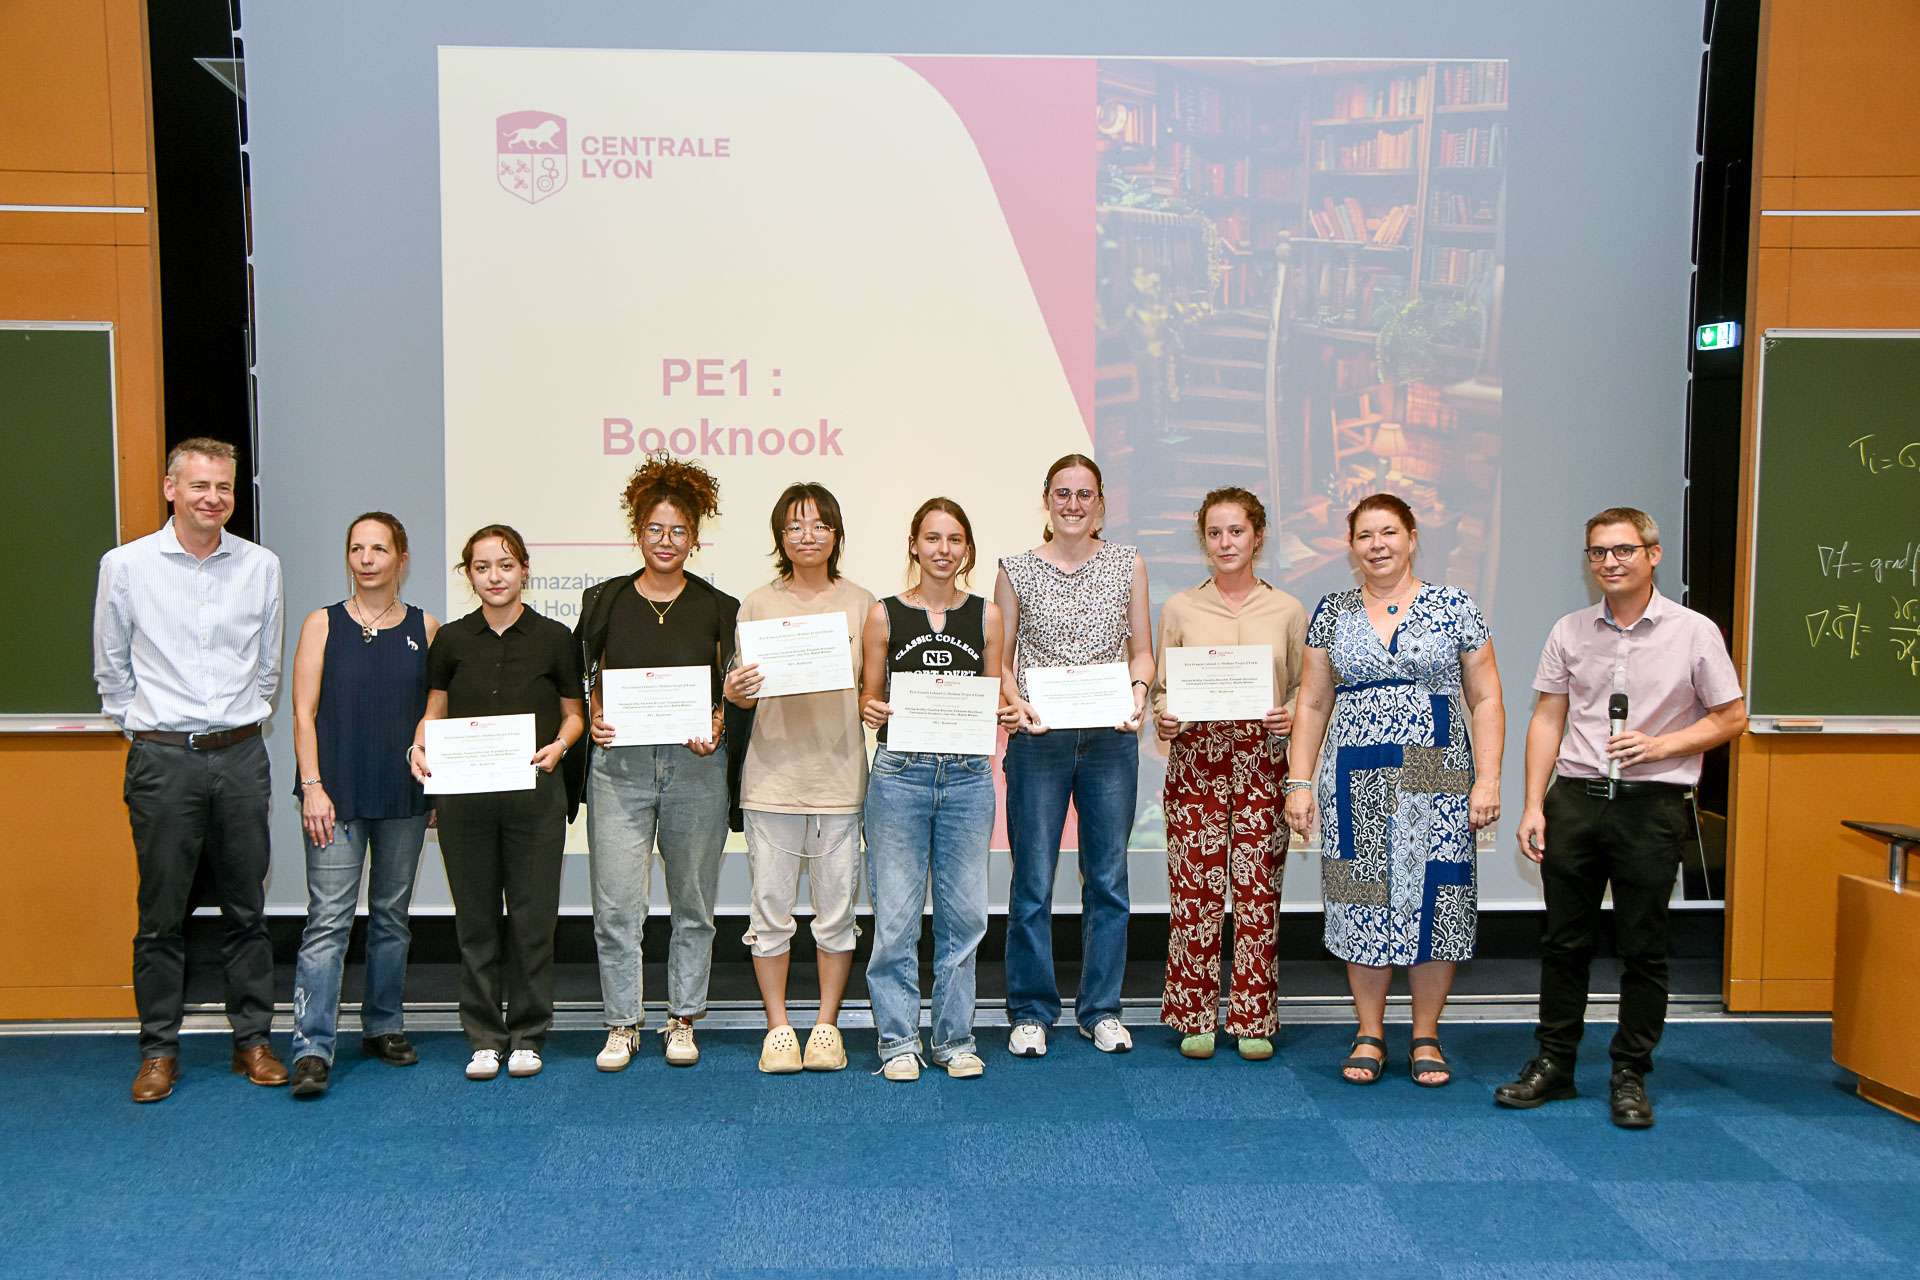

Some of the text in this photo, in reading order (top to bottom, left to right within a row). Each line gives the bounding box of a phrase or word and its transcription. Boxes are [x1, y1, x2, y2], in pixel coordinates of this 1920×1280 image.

[581, 136, 731, 158] CENTRALE
[582, 158, 653, 179] LYON
[662, 358, 748, 397] PE1
[602, 417, 844, 456] Booknook
[895, 634, 980, 661] CLASSIC COLLEGE
[925, 652, 950, 664] N5
